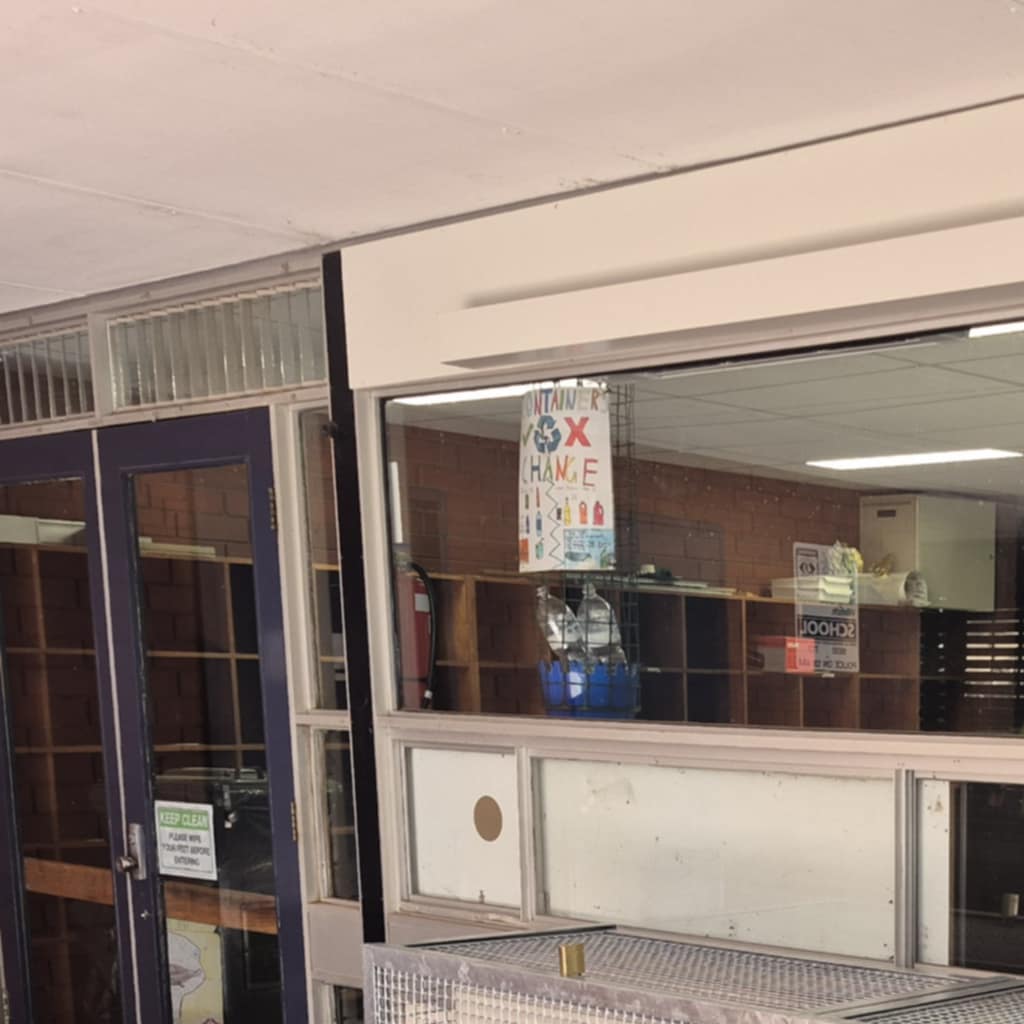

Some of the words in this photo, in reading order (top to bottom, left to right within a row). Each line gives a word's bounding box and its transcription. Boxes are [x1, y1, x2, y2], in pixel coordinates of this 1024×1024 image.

[522, 455, 599, 487] CHANGE
[160, 811, 181, 825] KEEP
[169, 832, 188, 842] PLEASE
